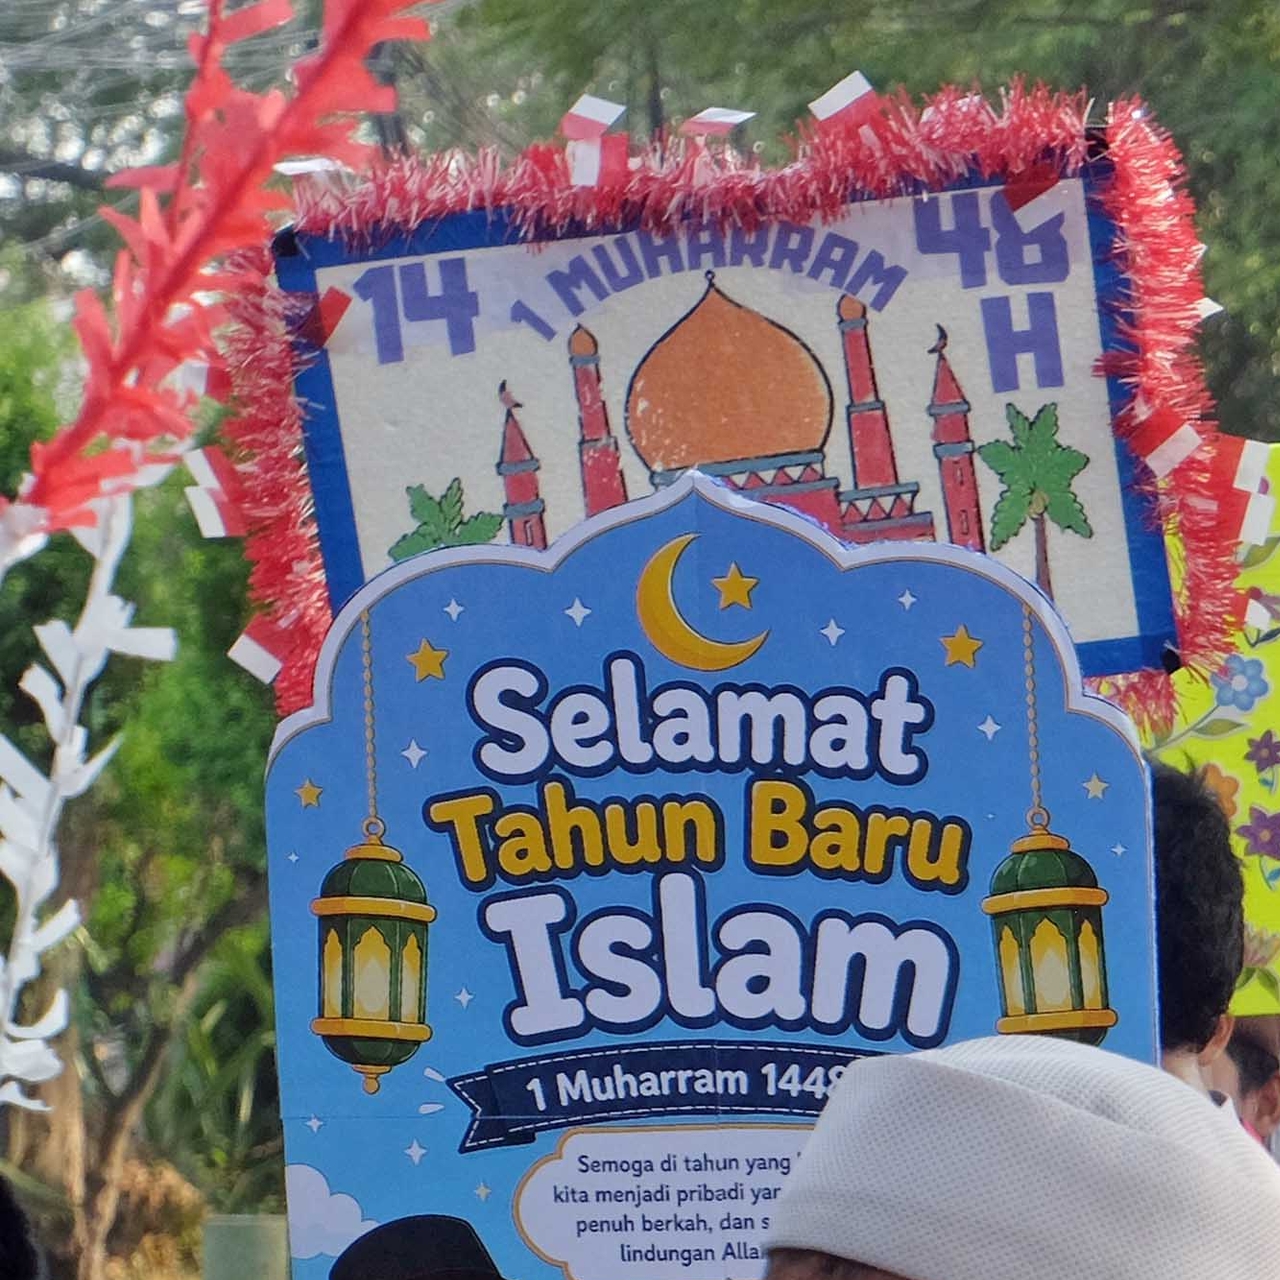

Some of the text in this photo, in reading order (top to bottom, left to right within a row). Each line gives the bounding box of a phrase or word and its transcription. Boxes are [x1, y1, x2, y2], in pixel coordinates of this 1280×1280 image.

[353, 256, 480, 366] 14
[511, 212, 909, 342] 1 MUHARRAM
[980, 291, 1065, 393] H
[468, 654, 931, 780] Selamat
[427, 776, 966, 888] Tahun Baru
[481, 869, 956, 1041] Islam
[526, 1078, 548, 1112] 1
[555, 1064, 749, 1106] Muharram
[553, 1184, 589, 1204] kita
[595, 1184, 671, 1208] menjadi
[677, 1183, 745, 1208] pribadi
[577, 1152, 791, 1178] Semoga di tahun yang
[576, 1214, 635, 1238] penuh
[641, 1213, 713, 1234] berkah,
[720, 1212, 755, 1231] dan
[620, 1242, 765, 1267] lindungan Alla
